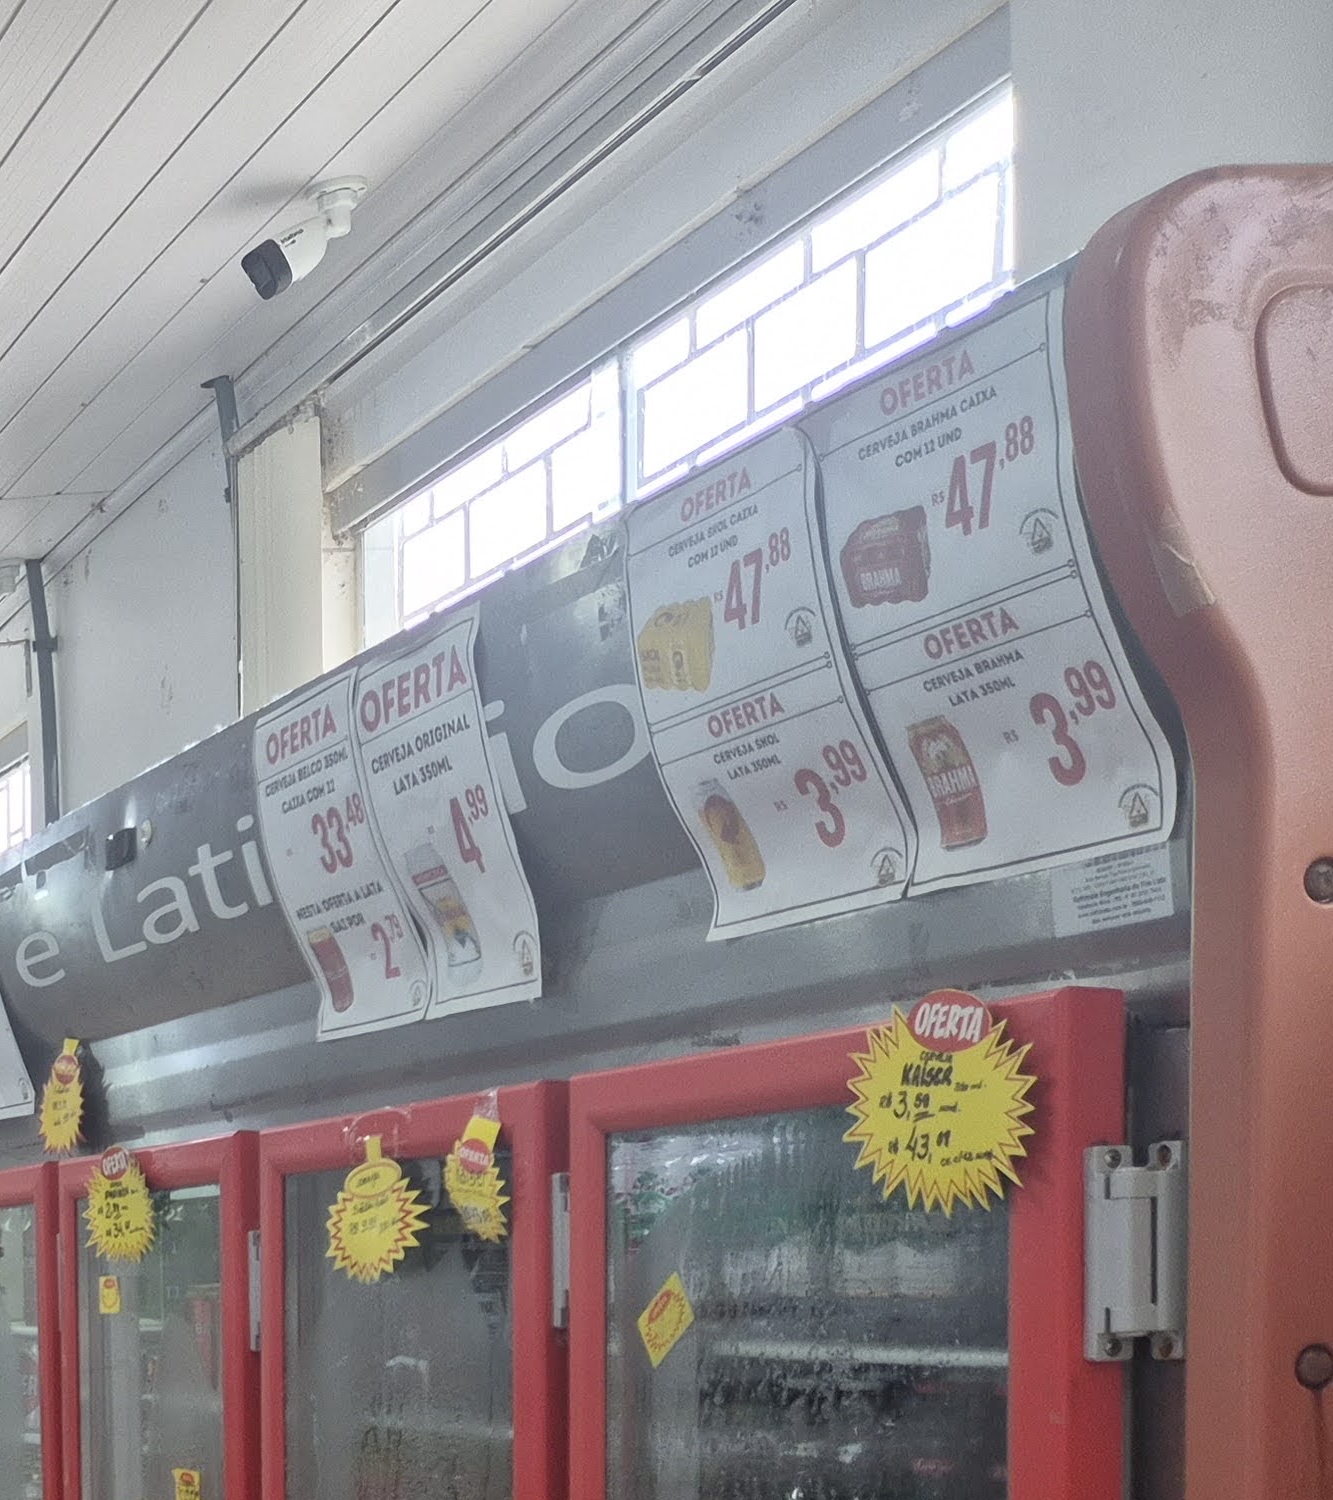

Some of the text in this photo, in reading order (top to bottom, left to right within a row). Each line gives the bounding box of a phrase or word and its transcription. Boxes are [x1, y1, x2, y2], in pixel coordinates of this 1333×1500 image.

[880, 350, 975, 416] OFERTA
[858, 387, 997, 461] CERVEJA BRAHMA CAIXA
[895, 446, 922, 467] COM
[937, 427, 962, 449] UND
[680, 467, 752, 523] OFERTA
[945, 415, 1035, 536] 47,88
[668, 530, 706, 557] CERVEJA
[707, 518, 729, 539] SKOL
[687, 549, 709, 568] COM
[720, 535, 739, 553] UND
[724, 527, 791, 631] 47,88
[924, 607, 1019, 660] OFERTA
[360, 644, 467, 733] OFERTA
[923, 650, 1024, 692] CERVEJA BRAHMA
[948, 676, 1016, 707] LATA 350ML
[266, 703, 337, 765] OFERTA
[707, 692, 785, 738] OFERTA
[1029, 660, 1116, 787] 3,99
[371, 713, 470, 774] CERVEJA ORIGINAL
[713, 733, 780, 765] CERVEJA SKOL
[727, 754, 782, 780] LATA 350ML
[393, 755, 453, 796] LATA 350ML
[794, 739, 867, 848] 3,99
[914, 1002, 984, 1043] OFERTA
